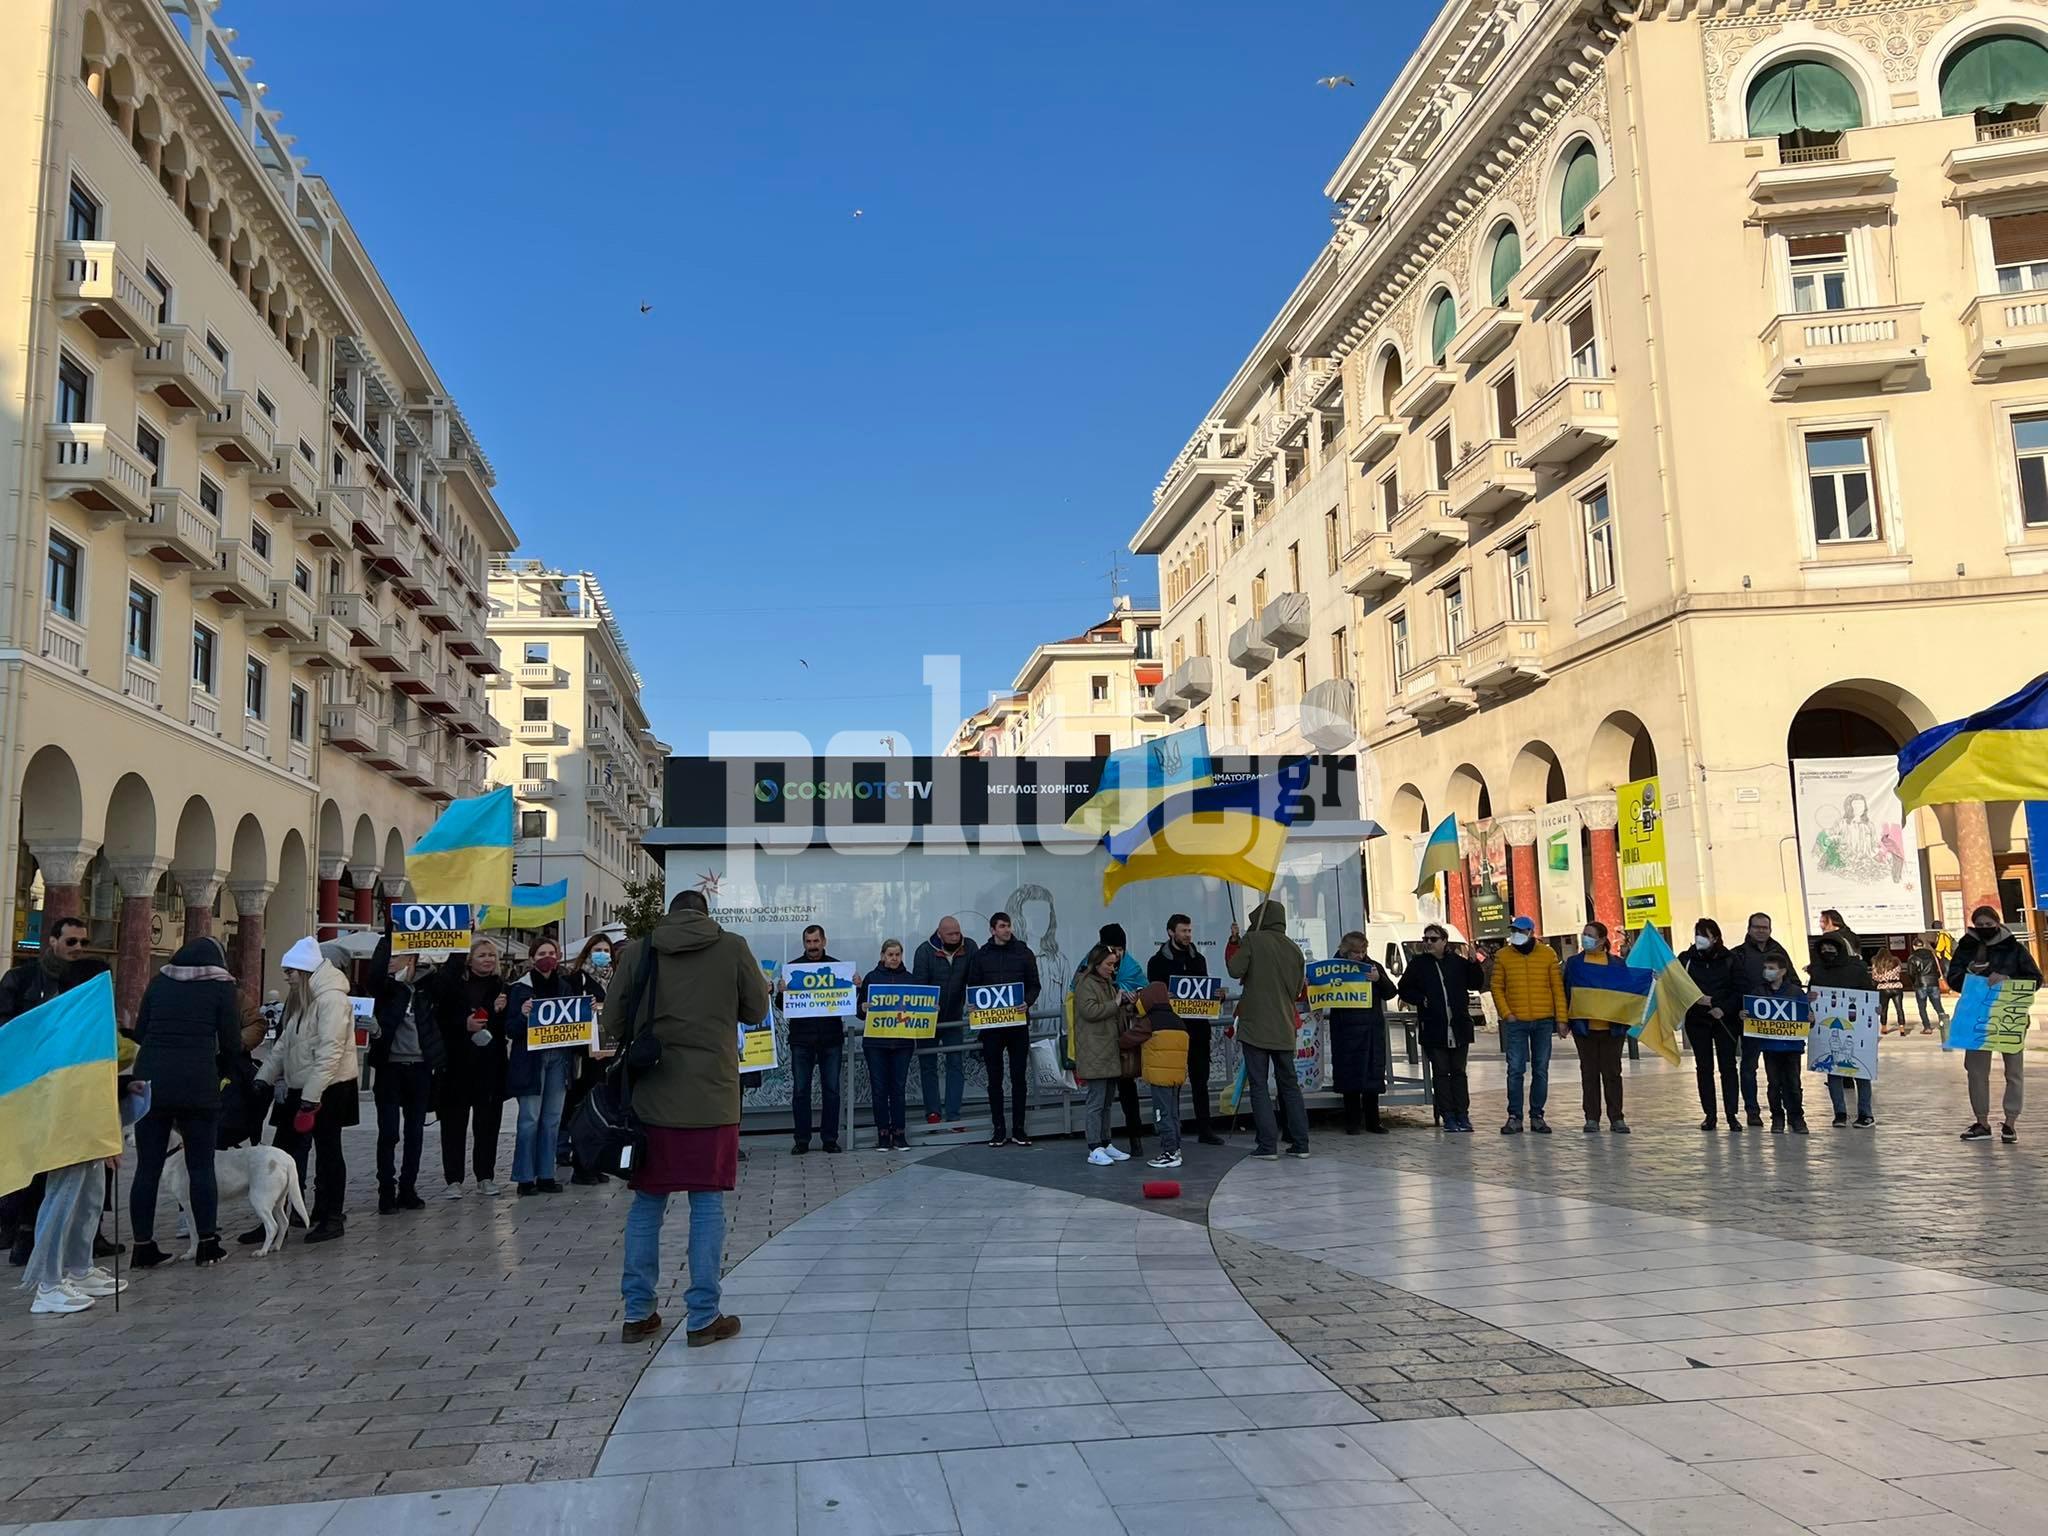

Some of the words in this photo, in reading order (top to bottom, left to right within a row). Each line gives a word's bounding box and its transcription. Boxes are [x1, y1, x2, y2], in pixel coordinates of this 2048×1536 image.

[783, 781, 901, 800] COSMOTE
[904, 781, 932, 799] TV
[987, 785, 1037, 794] ΜΕΓΑΛΟΣ
[1040, 784, 1089, 794] ΧΟΡΗΓΟΣ
[750, 906, 817, 914] DOCUMENTARY
[404, 905, 456, 931] ΟΧΙ
[400, 932, 420, 941] ΣΤΗ
[423, 931, 463, 940] ΡΩΣΙΚΗ
[408, 940, 455, 949] ΕΙΣΒΟΛΗ
[1315, 964, 1360, 977] BUCHA
[803, 974, 835, 988] ΟΧΙ
[1330, 978, 1343, 987] IS
[1176, 978, 1212, 999] ΟΧΙ
[871, 994, 900, 1006] STOP
[902, 994, 936, 1007] PUTIN
[975, 985, 1014, 1009] ΟΧΙ
[1310, 992, 1367, 1004] UKRAINE
[785, 1001, 807, 1009] ΣΤΗΝ
[809, 1000, 851, 1008] ΟΥΚΡΑΝΙΑ
[1753, 998, 1797, 1021] ΟΧΙ
[538, 998, 582, 1025] ΟΧΙ
[904, 1017, 930, 1028] WAR
[1769, 1021, 1803, 1030] ΡΩΣΙΚΗ
[534, 1028, 551, 1036] ΣΤΗ
[553, 1023, 586, 1034] ΡΩΣΙΚΗ
[1757, 1028, 1797, 1036] ΕΙΣΒΟΛΗ
[541, 1033, 579, 1044] ΕΙΣΒΟΛΗ
